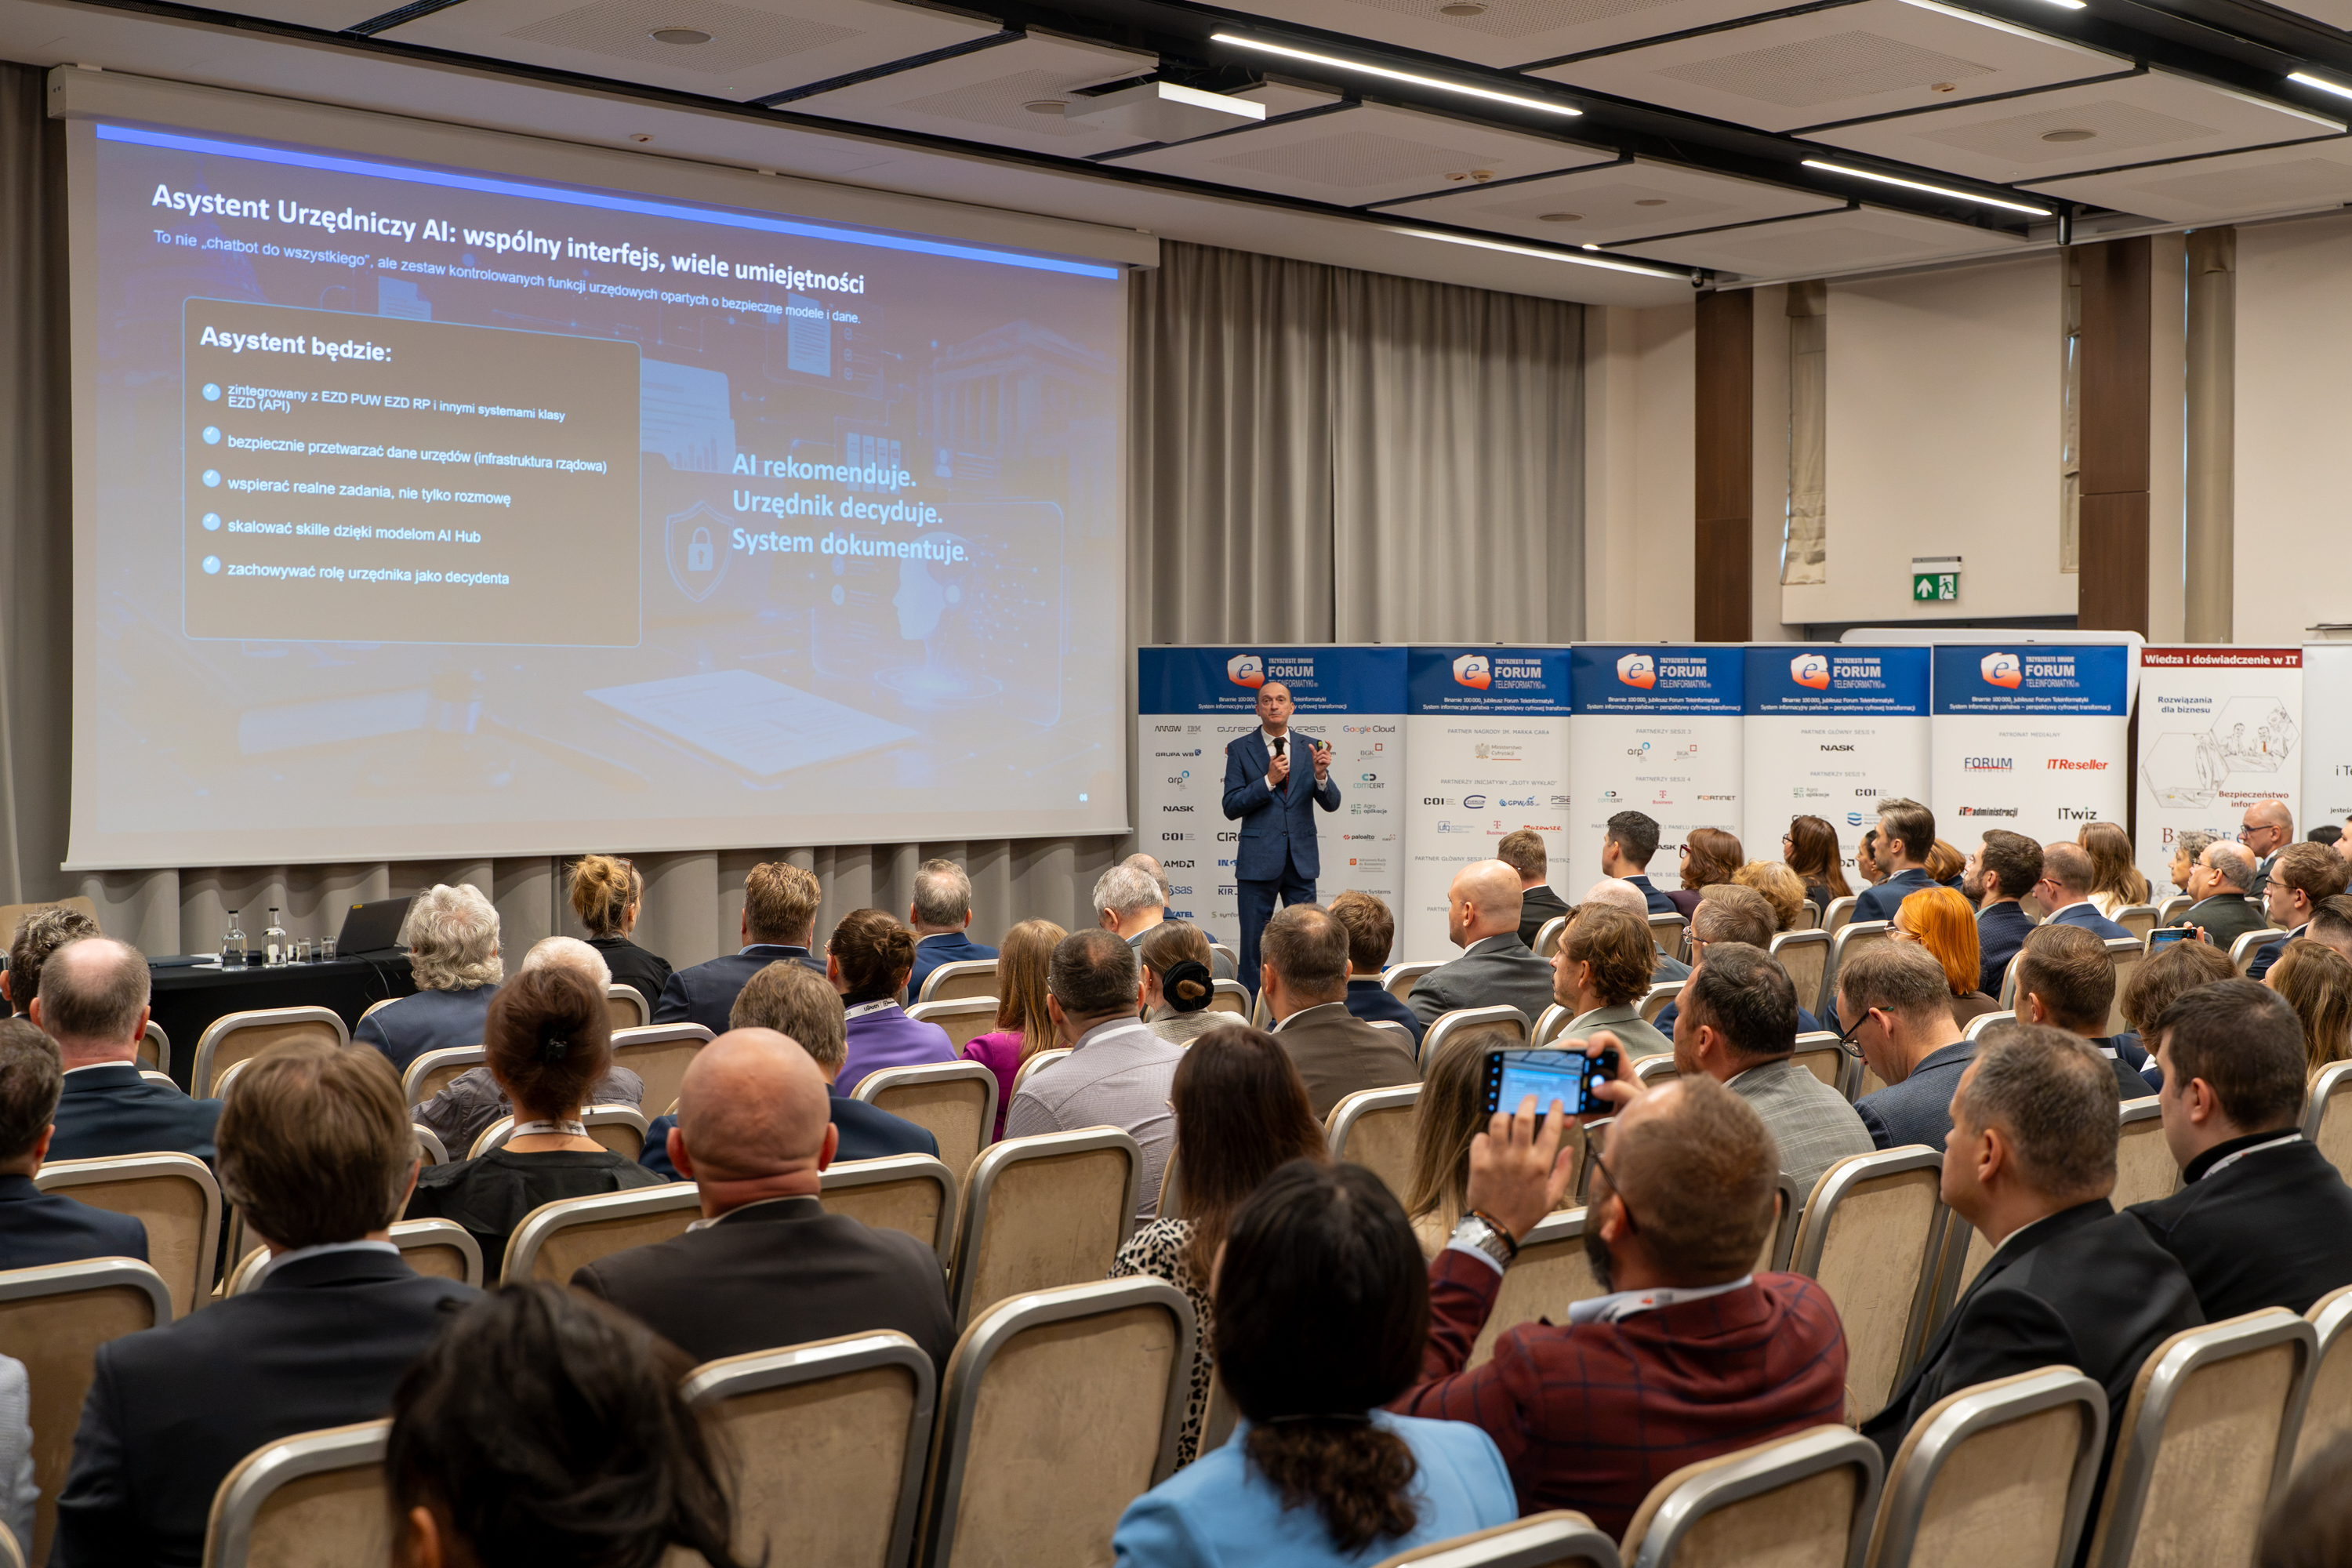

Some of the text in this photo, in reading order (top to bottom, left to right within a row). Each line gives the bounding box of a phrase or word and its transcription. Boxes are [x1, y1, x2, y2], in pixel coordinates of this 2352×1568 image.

[151, 184, 865, 294] Asystent Urzędniczy AI: wspólny interfejs, wiele umiejętności
[153, 230, 171, 244] To
[176, 233, 197, 247] nie
[262, 243, 280, 256] do
[377, 256, 397, 270] ale
[401, 260, 446, 276] zestaw
[449, 264, 545, 288] kontrolowanych
[547, 276, 586, 294] funkcji
[589, 283, 658, 301] urzędowych
[660, 292, 709, 307] opartych
[711, 298, 720, 307] o
[721, 297, 783, 314] bezpieczne
[786, 305, 825, 320] modele
[826, 309, 829, 320] i
[832, 309, 861, 324] dane.
[199, 326, 392, 362] Asystent będzie:
[227, 384, 566, 423] zintegrowany z EZD PUW EZD RP i innymi systemami klasy
[228, 396, 291, 414] EZD (API)
[227, 434, 608, 474] bezpiecznie przetwarzać dane urzędów (infrastruktura rządowa)
[732, 453, 917, 491] AI rekomenduje.
[227, 478, 511, 508] wspierać realne zadania, nie tylko rozmowę
[733, 489, 943, 528] Urzędnik decyduje.
[227, 520, 481, 543] skalować skille dzięki modelom AI Hub
[732, 528, 969, 565] System dokumentuje.
[227, 563, 510, 586] zachowywać rolę urzędnika jako decydenta
[2144, 654, 2184, 665] Wiedza
[2186, 655, 2190, 664] i
[2192, 654, 2270, 665] doświadczenie
[2285, 656, 2299, 665] IT
[1268, 666, 1314, 677] FORUM
[1494, 666, 1541, 678] FORUM
[1659, 666, 1708, 677] FORUM
[1833, 666, 1881, 677] FORUM
[2025, 664, 2075, 677] FORUM
[1342, 725, 1371, 734] Google
[1965, 757, 2013, 768] FORUM
[2219, 790, 2289, 799] Bezpieczeństwo
[1972, 808, 2018, 818] administracji
[2058, 807, 2097, 820] ITwiz
